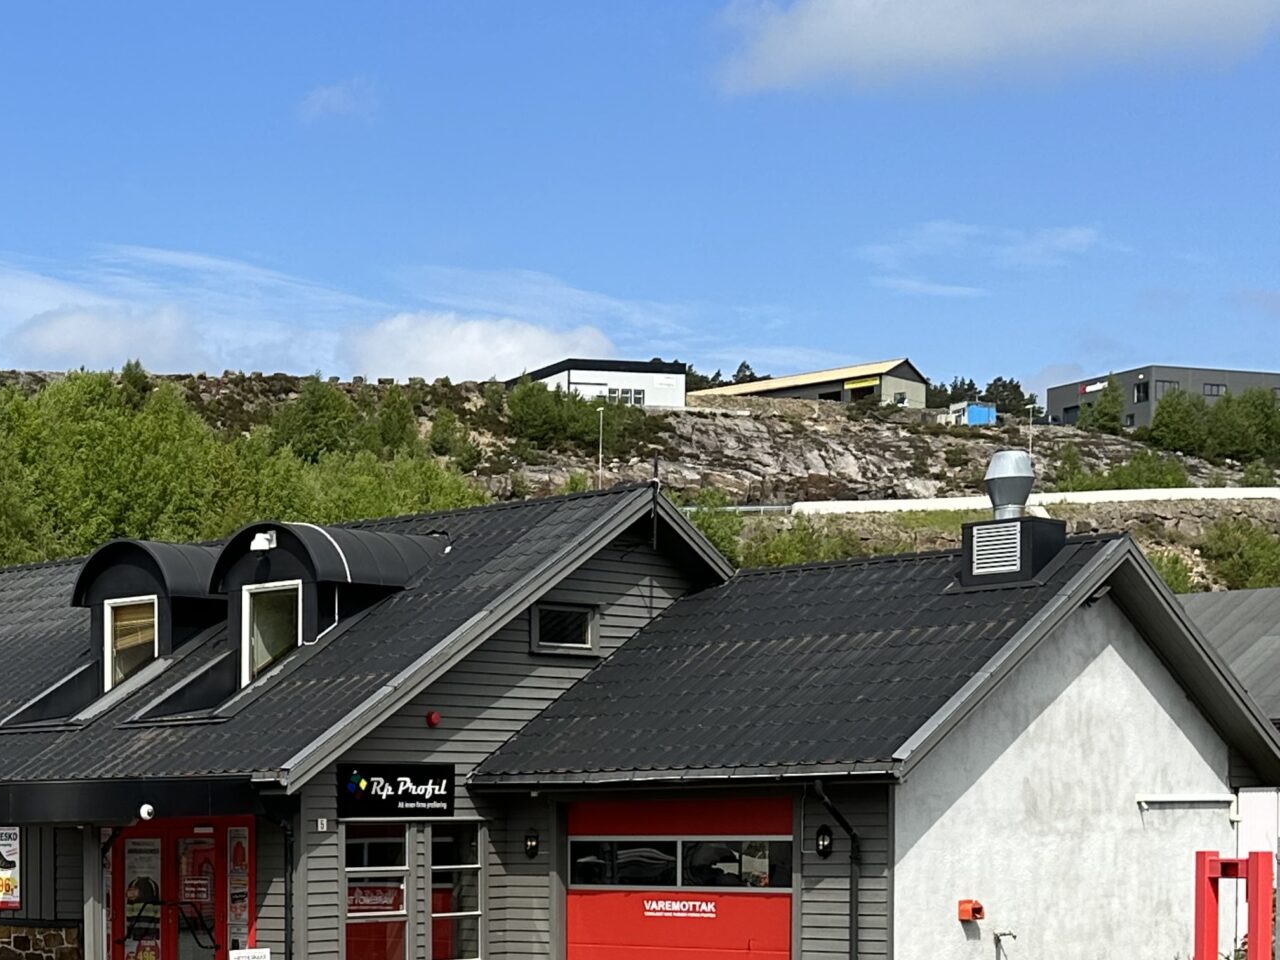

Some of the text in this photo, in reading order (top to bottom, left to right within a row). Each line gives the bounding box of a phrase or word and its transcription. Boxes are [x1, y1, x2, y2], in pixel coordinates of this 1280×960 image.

[370, 777, 448, 799] Rp Profil
[643, 900, 716, 912] VAREMOTTAK
